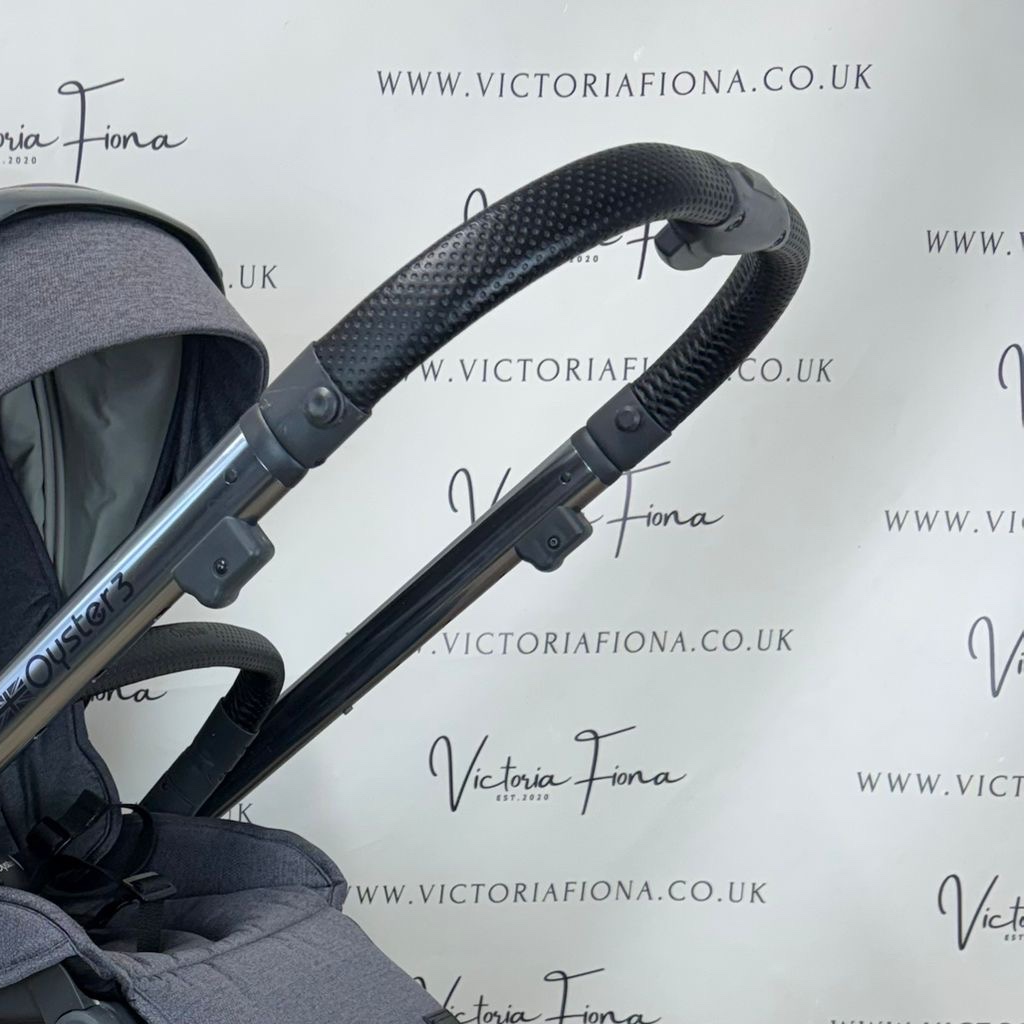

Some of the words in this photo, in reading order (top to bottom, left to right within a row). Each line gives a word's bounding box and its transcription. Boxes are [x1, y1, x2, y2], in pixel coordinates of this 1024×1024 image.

[376, 64, 873, 100] WWW.VICTORIAFIONA.CO.UK
[58, 79, 187, 183] Fiona
[927, 230, 1024, 255] WWW.
[429, 735, 571, 812] Victoria
[574, 725, 687, 815] Fiona
[347, 880, 766, 905] WW.VICTORIAFIONA.CO.UK
